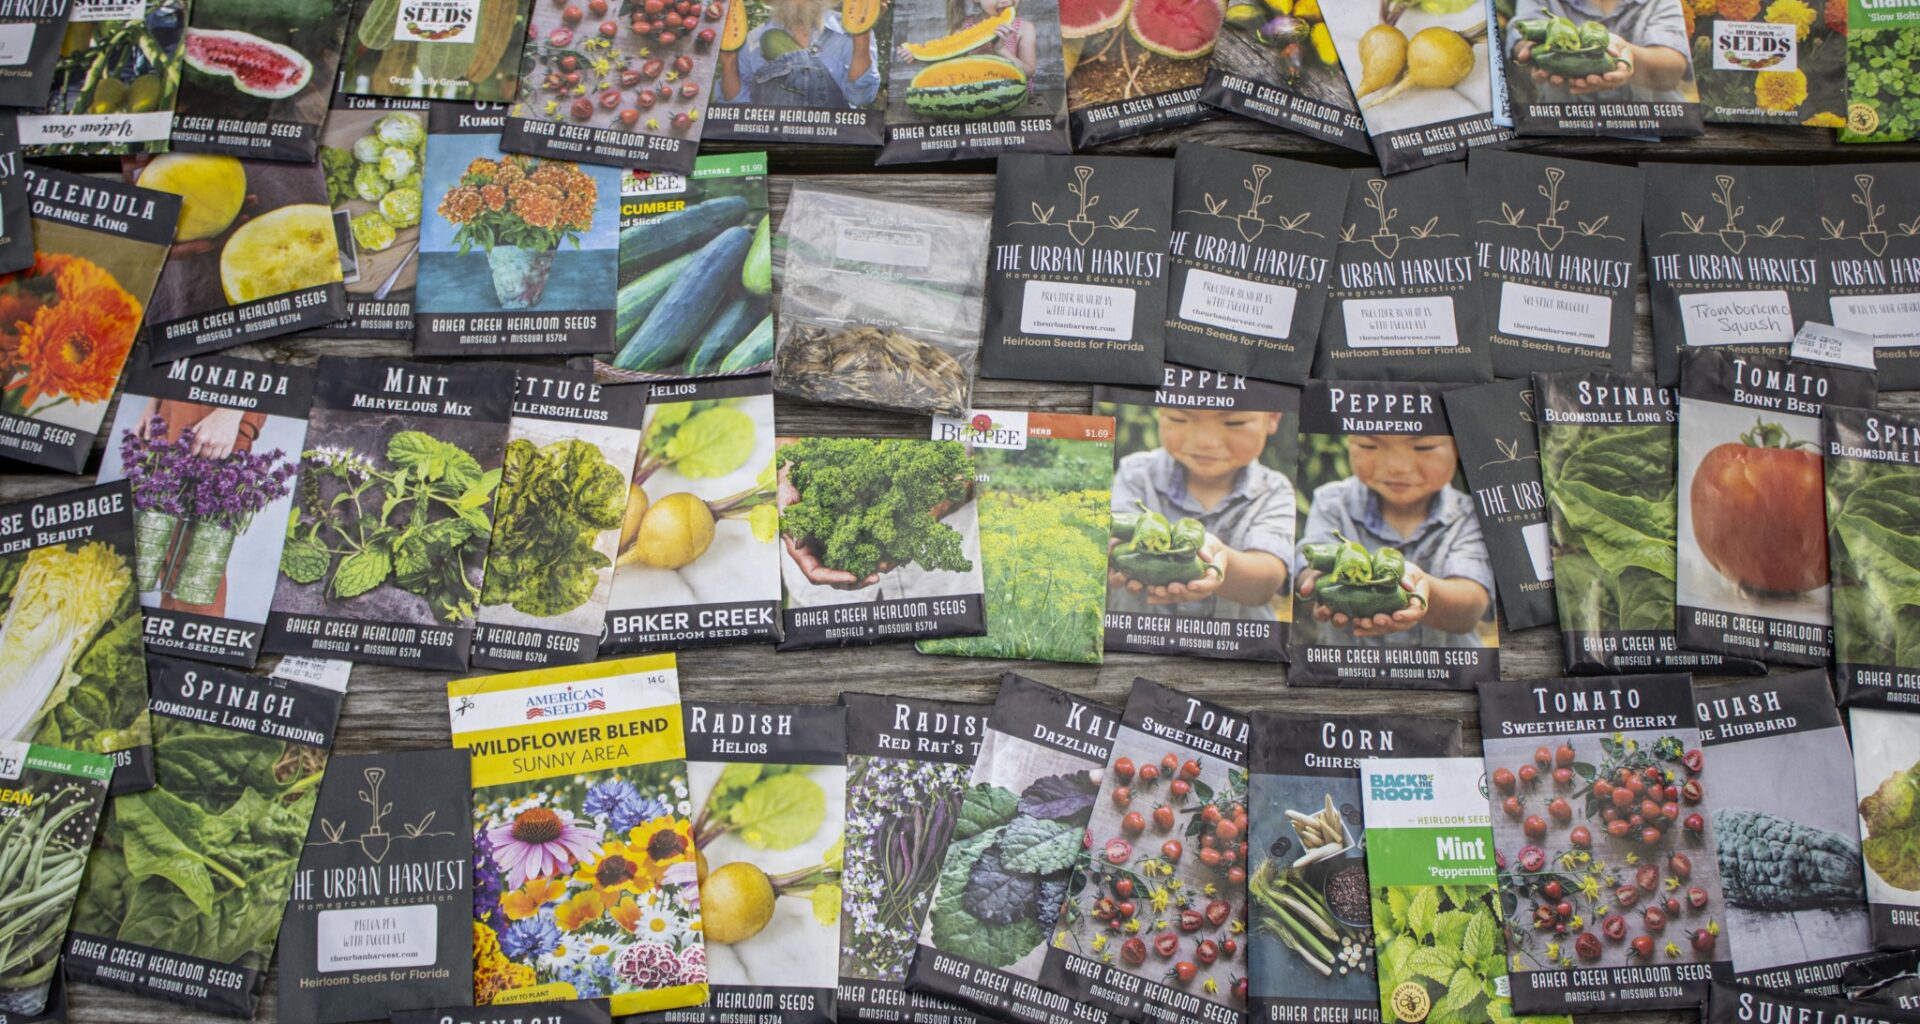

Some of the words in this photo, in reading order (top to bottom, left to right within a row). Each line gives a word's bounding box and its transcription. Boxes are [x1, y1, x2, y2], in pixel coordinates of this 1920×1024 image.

[404, 7, 472, 23] SEEDS
[1719, 35, 1791, 52] SEEDS
[438, 78, 469, 87] Grown
[347, 97, 375, 109] TOM
[1715, 106, 1765, 117] Organically
[1767, 109, 1798, 117] Grown
[707, 107, 740, 120] BAKER
[744, 108, 776, 121] CREEK
[780, 109, 830, 123] HEIRLOOM
[835, 113, 866, 125] SEEDS
[80, 119, 134, 137] Yellow
[734, 124, 769, 133] MANSFIELD
[782, 125, 814, 135] MISSOURI
[816, 126, 837, 135] 65704
[740, 163, 763, 173] $1.99
[23, 169, 155, 220] CALENDULA
[31, 201, 90, 227] ORANGE
[92, 212, 128, 234] KING
[632, 217, 661, 227] Slicer
[996, 244, 1023, 271] THE
[1030, 245, 1085, 274] URBAN
[1091, 251, 1164, 278] HARVEST
[1194, 234, 1248, 269] URBAN
[1254, 245, 1328, 284] HARVEST
[1500, 246, 1553, 279] URBAN
[1560, 252, 1632, 289] HARVEST
[1005, 271, 1080, 282] Homegrown
[1086, 274, 1151, 287] Education
[1340, 260, 1396, 289] URBAN
[1401, 256, 1472, 284] HARVEST
[1652, 255, 1681, 281] THE
[1689, 255, 1743, 282] URBAN
[1748, 257, 1817, 285] HARVEST
[1830, 258, 1885, 286] URBAN
[1247, 272, 1311, 290] Education
[1400, 285, 1464, 294] Education
[1554, 280, 1618, 296] Education
[1667, 282, 1740, 290] Homegrown
[1748, 282, 1809, 292] Education
[432, 319, 465, 332] BAKER
[470, 318, 502, 331] CREEK
[507, 317, 559, 331] HEIRLOOM
[565, 316, 596, 330] SEEDS
[1719, 318, 1781, 339] Squash
[460, 334, 497, 344] MANSFIELD
[510, 334, 543, 343] MISSOURI
[545, 334, 567, 343] 65704
[1003, 335, 1051, 347] Heirloom
[1053, 338, 1086, 349] Seeds
[1089, 340, 1104, 350] for
[1107, 340, 1144, 351] Florida
[1331, 347, 1379, 359] Heirloom
[1382, 347, 1414, 357] Seeds
[1417, 346, 1432, 356] for
[1434, 344, 1471, 355] Florida
[167, 357, 289, 395] MONARDA
[383, 367, 449, 396] MINT
[1733, 359, 1828, 398] TOMATO
[188, 386, 258, 409] BERGAMO
[352, 394, 438, 414] MARVELOUS
[443, 402, 472, 417] MIX
[1155, 390, 1235, 407] NADAPENO
[1329, 387, 1433, 414] PEPPER
[1733, 389, 1782, 408] BONNY
[1786, 398, 1823, 415] BEST
[1342, 417, 1423, 432] NADAPENO
[1544, 408, 1624, 422] BLOOMSDALE
[1627, 410, 1661, 422] LONG
[1030, 427, 1051, 436] HERB
[1085, 429, 1109, 438] $1.69
[1831, 442, 1910, 463] BLOOMSDALE
[31, 492, 125, 529] CABBAGE
[1476, 485, 1509, 517] THE
[37, 524, 94, 547] BEAUTY
[612, 613, 689, 634] BAKER
[698, 606, 774, 628] CREEK
[795, 612, 830, 626] BAKER
[834, 607, 868, 622] CREEK
[873, 601, 928, 619] HEIRLOOM
[933, 600, 967, 617] SEEDS
[639, 631, 704, 643] HEIRLOOM
[709, 628, 748, 638] SEEDS
[825, 626, 864, 639] MANSFIELD
[878, 622, 913, 634] MISSOURI
[915, 621, 938, 633] 65704
[1307, 648, 1341, 664] BAKER
[1346, 649, 1380, 663] CREEK
[1385, 650, 1439, 665] HEIRLOOM
[1445, 651, 1478, 666] SEEDS
[648, 676, 656, 685] 14
[657, 675, 665, 684] G
[1338, 667, 1376, 678] MANSFIELD
[1390, 668, 1424, 679] MISSOURI
[1427, 669, 1450, 679] 65704
[180, 671, 295, 719] SPINACH
[526, 687, 604, 707] AMERICAN
[1532, 688, 1640, 714] TOMATO
[543, 702, 588, 718] SEED
[222, 710, 257, 732] LONG
[261, 719, 324, 745] STANDING
[690, 706, 792, 736] RADISH
[1502, 718, 1606, 736] SWEETHEART
[1612, 714, 1678, 729] CHERRY
[1720, 716, 1797, 738] HUBBARD
[468, 727, 601, 758] WILDFLOWER
[606, 718, 668, 740] BLEND
[712, 739, 767, 754] HELIOS
[878, 734, 911, 750] RED
[918, 737, 964, 755] RAT'S
[1033, 723, 1109, 760] DAZZLING
[1142, 716, 1244, 762] SWEETHEART
[1322, 722, 1394, 751] CORN
[27, 758, 72, 772] VEGETABLE
[82, 764, 106, 777] $1.69
[512, 756, 575, 775] SUNNY
[581, 744, 629, 763] AREA
[1305, 753, 1361, 769] CHIRES
[1370, 774, 1418, 788] BACK
[1419, 780, 1433, 788] THE
[1370, 788, 1434, 800] ROOTS
[1436, 836, 1486, 861] Mint
[322, 866, 381, 899] URBAN
[389, 860, 466, 895] HARVEST
[298, 899, 376, 912] Homegrown
[384, 894, 453, 906] Education
[71, 938, 106, 961] BAKER
[110, 947, 144, 969] CREEK
[148, 955, 204, 981] HEIRLOOM
[208, 968, 243, 989] SEEDS
[96, 965, 135, 983] MANSFIELD
[148, 977, 183, 994] MISSOURI
[185, 986, 208, 998] 65704
[300, 974, 350, 988] Heirloom
[352, 972, 387, 984] Seeds
[390, 970, 408, 980] for
[409, 968, 449, 980] Florida
[1531, 972, 1568, 989] BAKER
[1573, 970, 1608, 985] CREEK
[1614, 966, 1671, 983] HEIRLOOM
[1677, 964, 1712, 980] SEEDS
[502, 995, 518, 1003] EASY
[519, 993, 529, 1001] TO
[530, 991, 550, 1000] PLANT
[1564, 989, 1606, 1002] MANSFIELD
[1620, 987, 1657, 1000] MISSOURI
[1659, 986, 1683, 997] 65704
